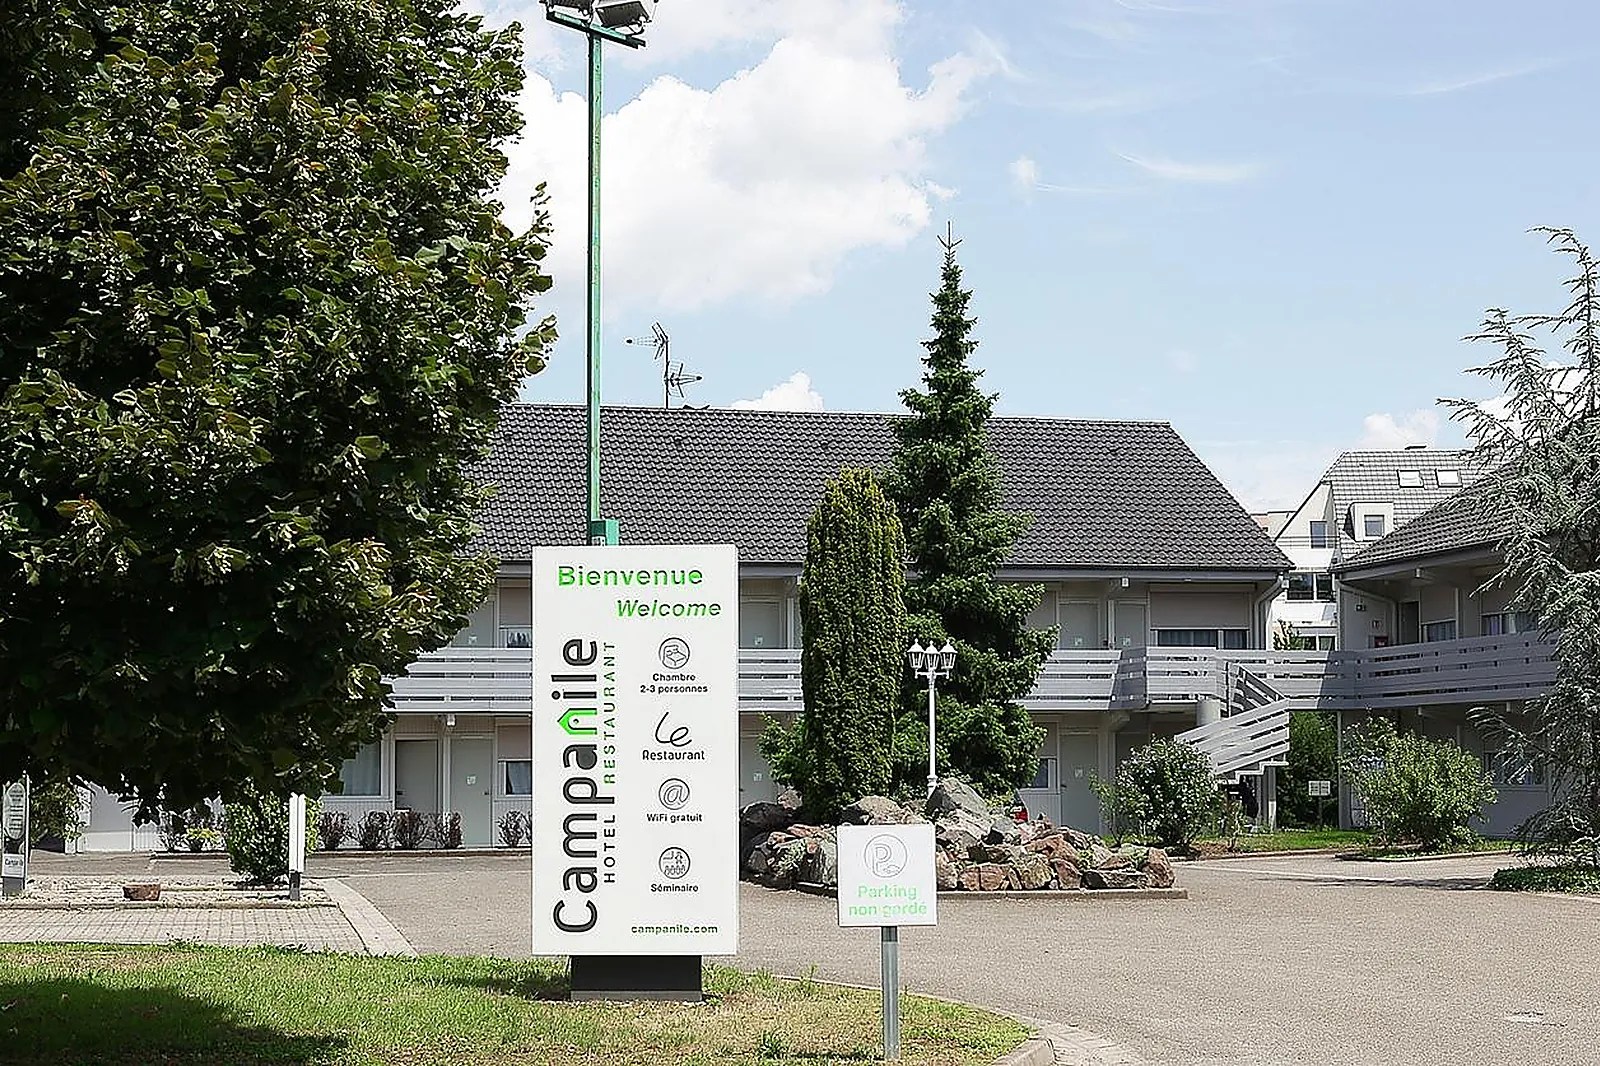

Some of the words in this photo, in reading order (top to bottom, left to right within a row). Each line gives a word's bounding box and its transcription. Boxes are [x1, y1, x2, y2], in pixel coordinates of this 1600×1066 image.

[558, 565, 703, 586] Bienvenue
[616, 599, 721, 617] Welcome
[652, 673, 696, 682] Chambre
[640, 685, 656, 694] 2-3
[658, 685, 708, 695] personnes
[603, 642, 616, 784] RESTAURANT
[642, 749, 705, 761] Restaurant
[551, 638, 615, 933] Campanile
[646, 813, 668, 822] WiFi
[670, 813, 703, 824] gratuit
[603, 814, 616, 884] HOTEL
[650, 883, 699, 893] Séminaire
[857, 884, 918, 900] Parking
[848, 905, 878, 917] non
[882, 901, 928, 918] gardé
[631, 924, 718, 935] campanile.com
